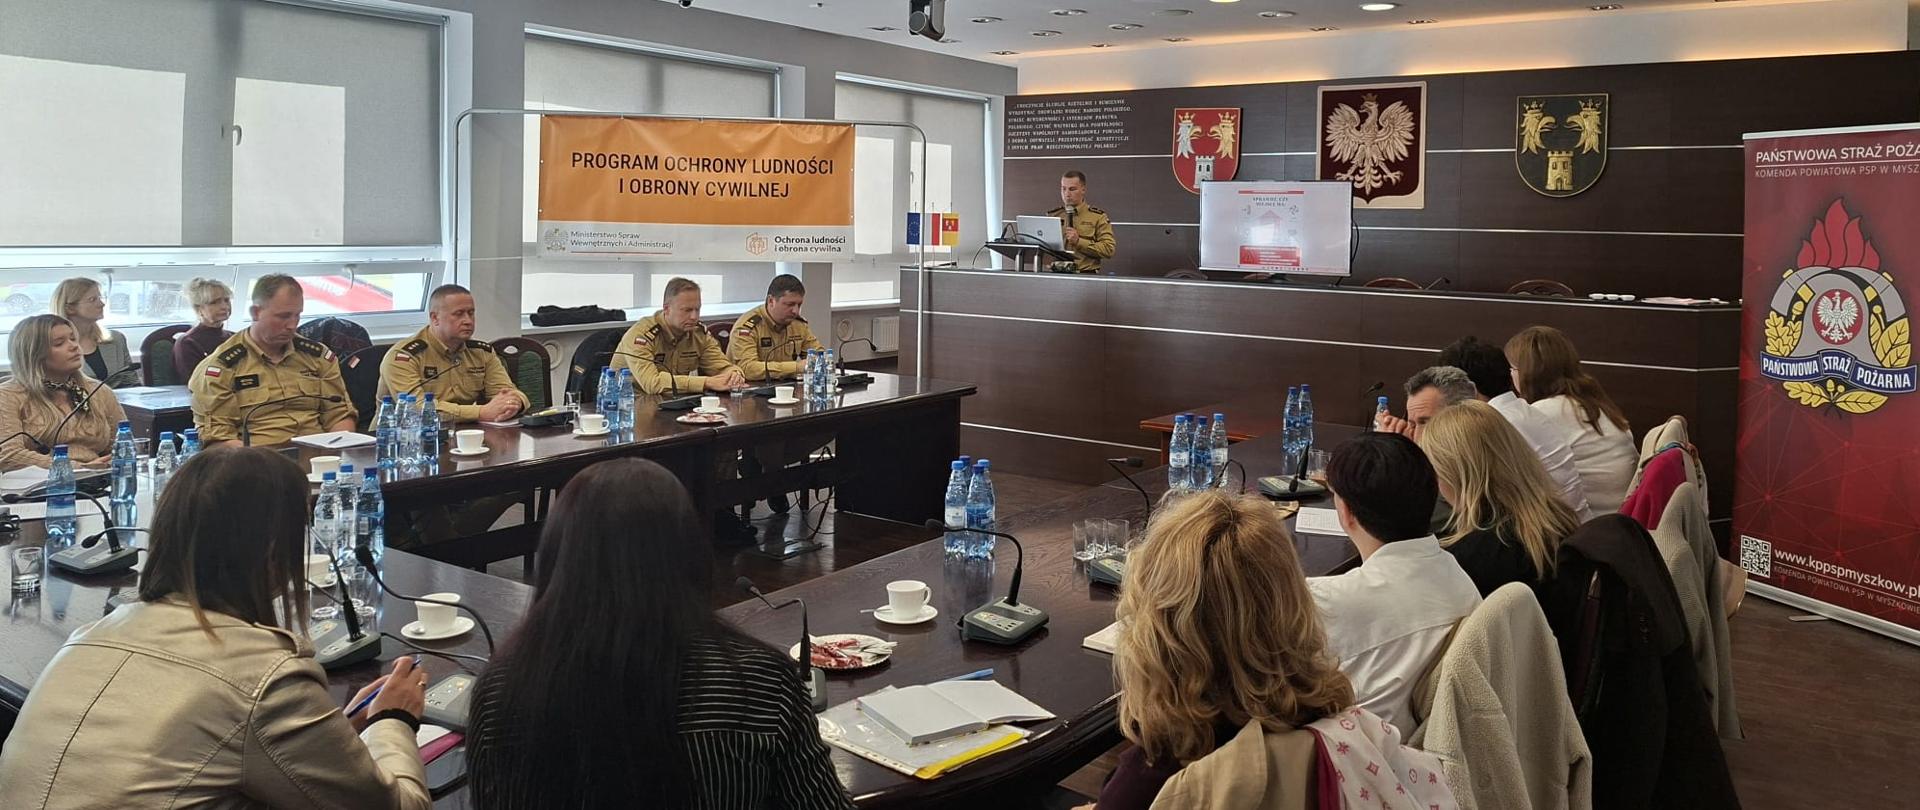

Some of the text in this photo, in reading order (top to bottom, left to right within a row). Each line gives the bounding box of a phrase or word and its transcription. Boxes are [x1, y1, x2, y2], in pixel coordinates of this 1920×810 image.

[1756, 148, 1838, 163] PAŃSTWOWA
[1840, 143, 1883, 159] STRAŻ
[571, 152, 834, 175] PROGRAM OCHRONY LUDNOŚCI
[1755, 168, 1797, 178] KOMENDA
[1800, 166, 1857, 177] POWIATOWA
[1859, 165, 1877, 176] PSP
[1880, 165, 1889, 174] W
[618, 178, 790, 198] I OBRONY CYWILNEJ
[571, 231, 641, 240] Ministerstwo Spraw
[774, 235, 846, 244] Ochrona ludności
[570, 240, 624, 248] Wewnętrznych
[628, 241, 674, 249] Administracji
[778, 244, 809, 253] obrona
[809, 244, 842, 253] cywilna
[1763, 356, 1911, 388] PAŃSTWOWA STRAŻ POŻARNA
[1773, 566, 1807, 580] KOMENDA
[1807, 575, 1850, 593] POWIATOWA
[1852, 587, 1865, 598] PSP
[1867, 592, 1874, 600] W
